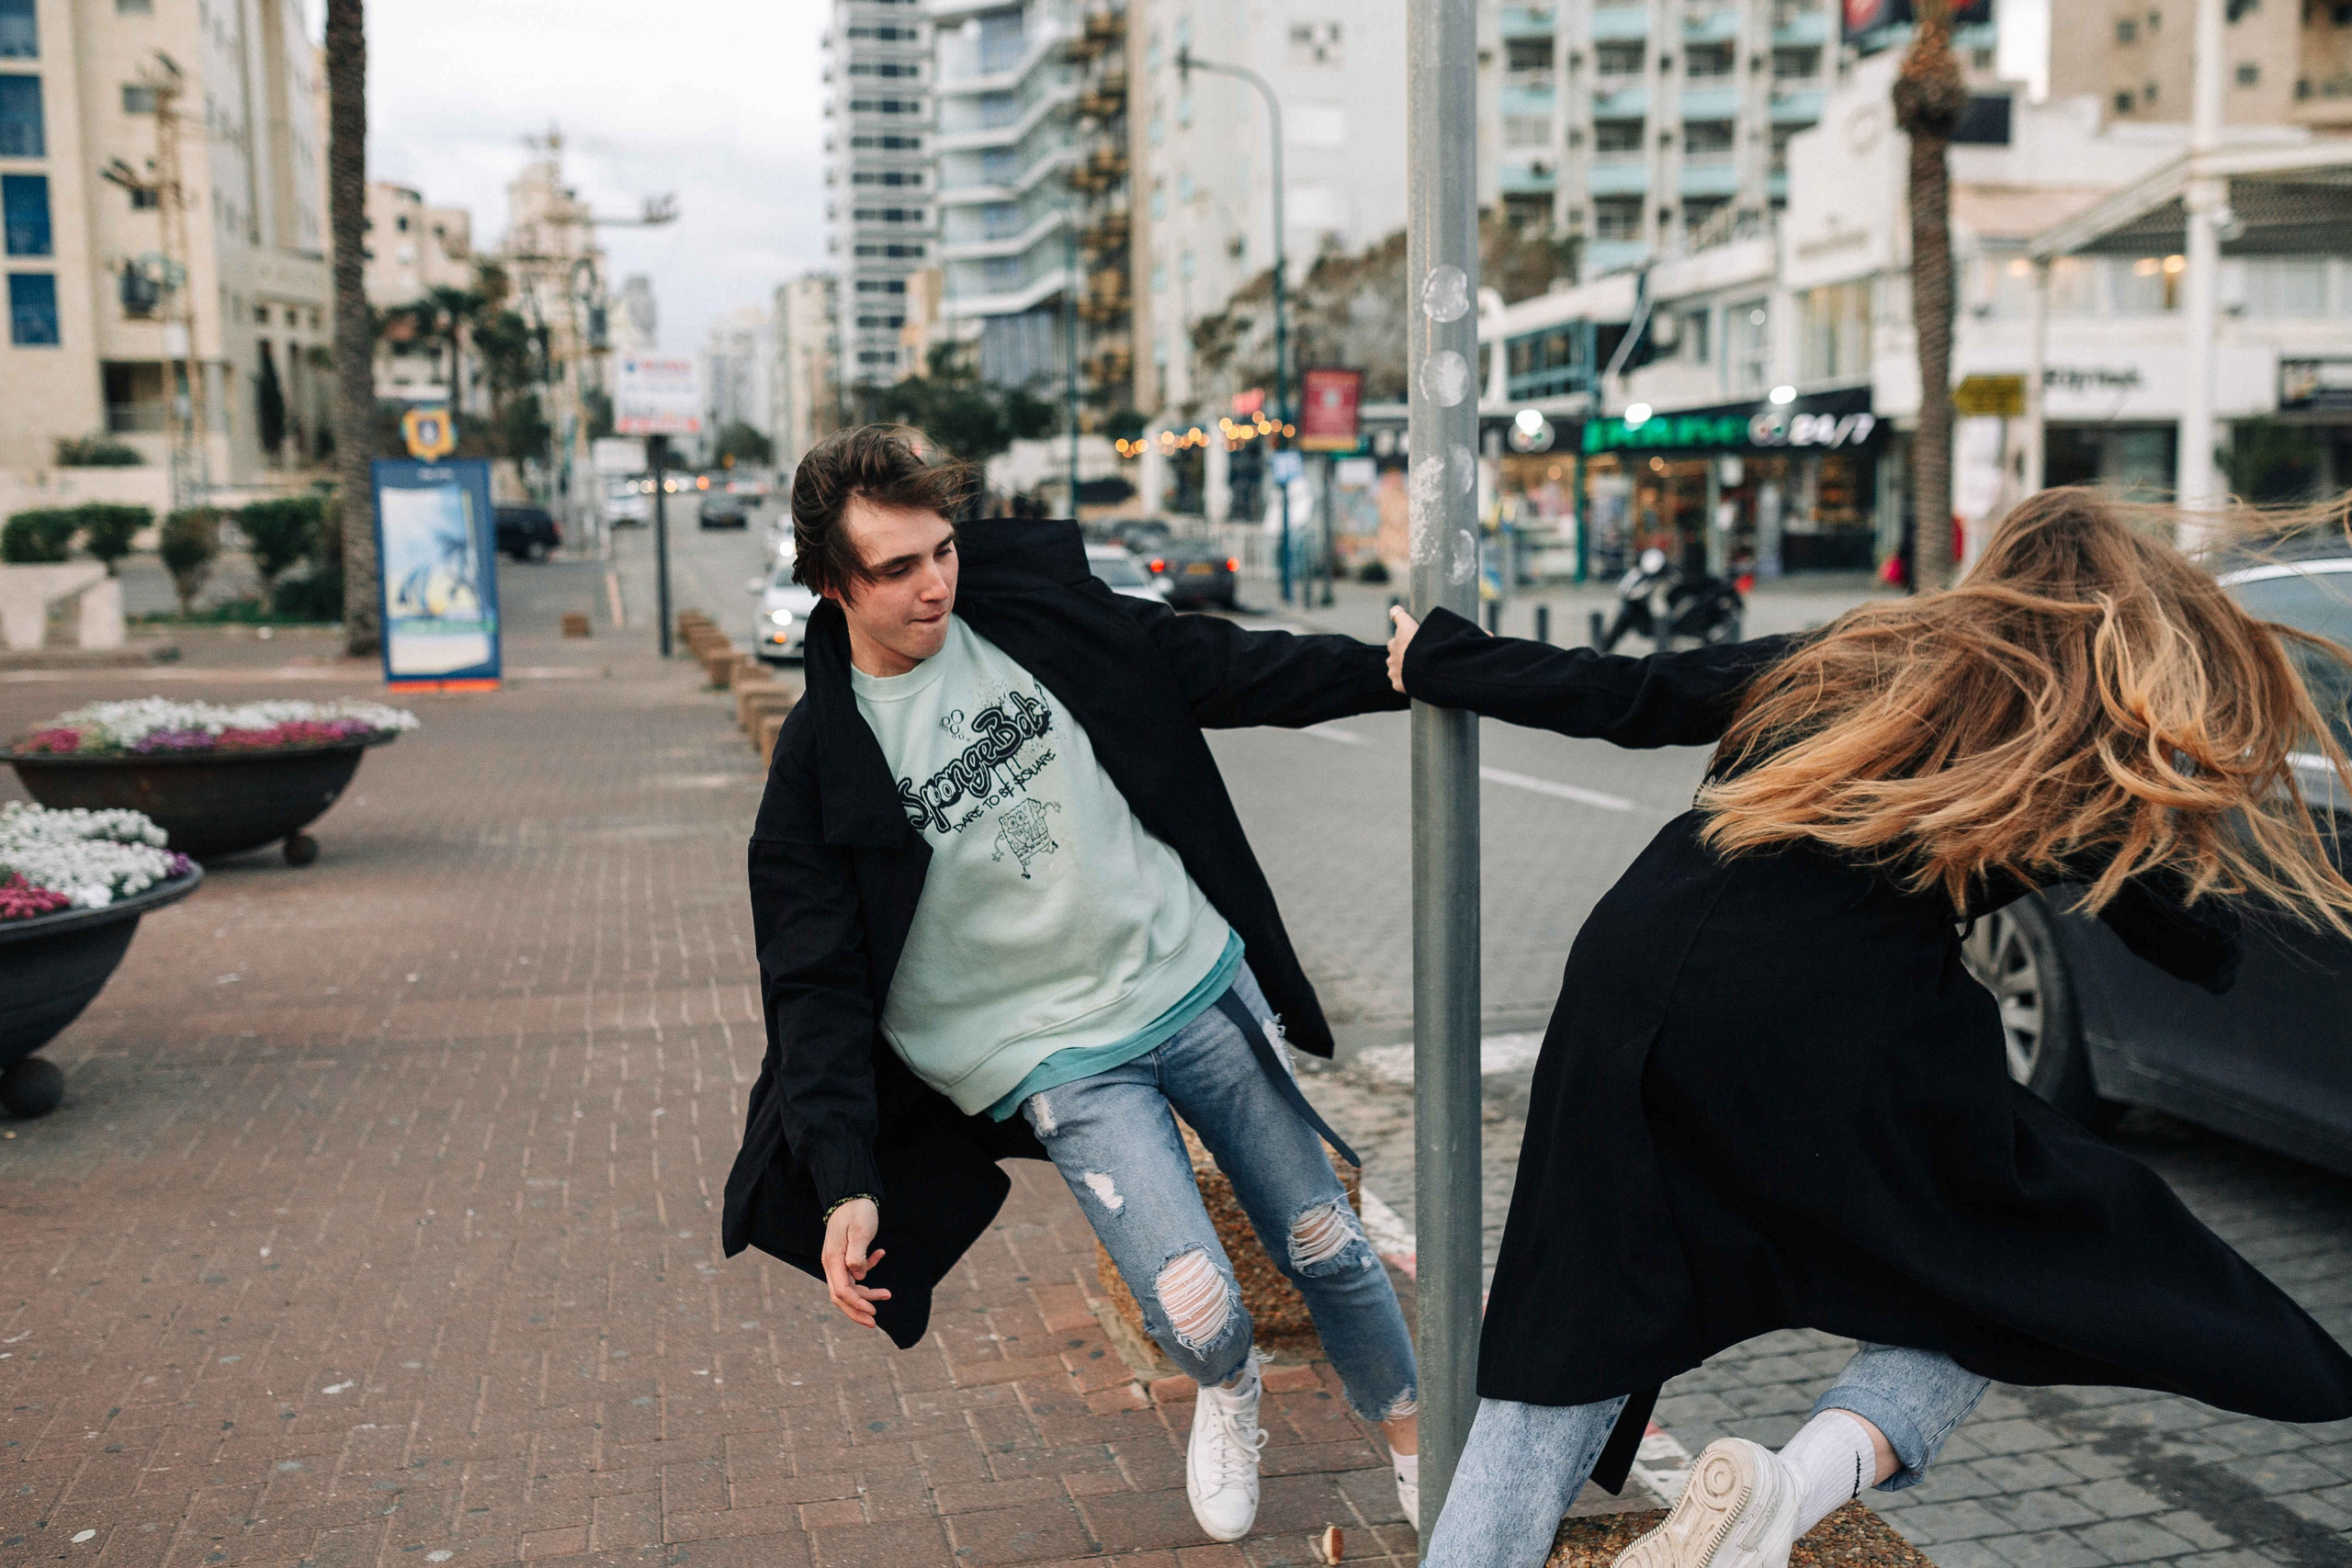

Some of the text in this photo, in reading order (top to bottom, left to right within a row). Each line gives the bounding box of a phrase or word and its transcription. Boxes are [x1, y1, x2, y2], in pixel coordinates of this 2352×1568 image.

[953, 749, 1056, 833] DARE TO BE SQUARE
